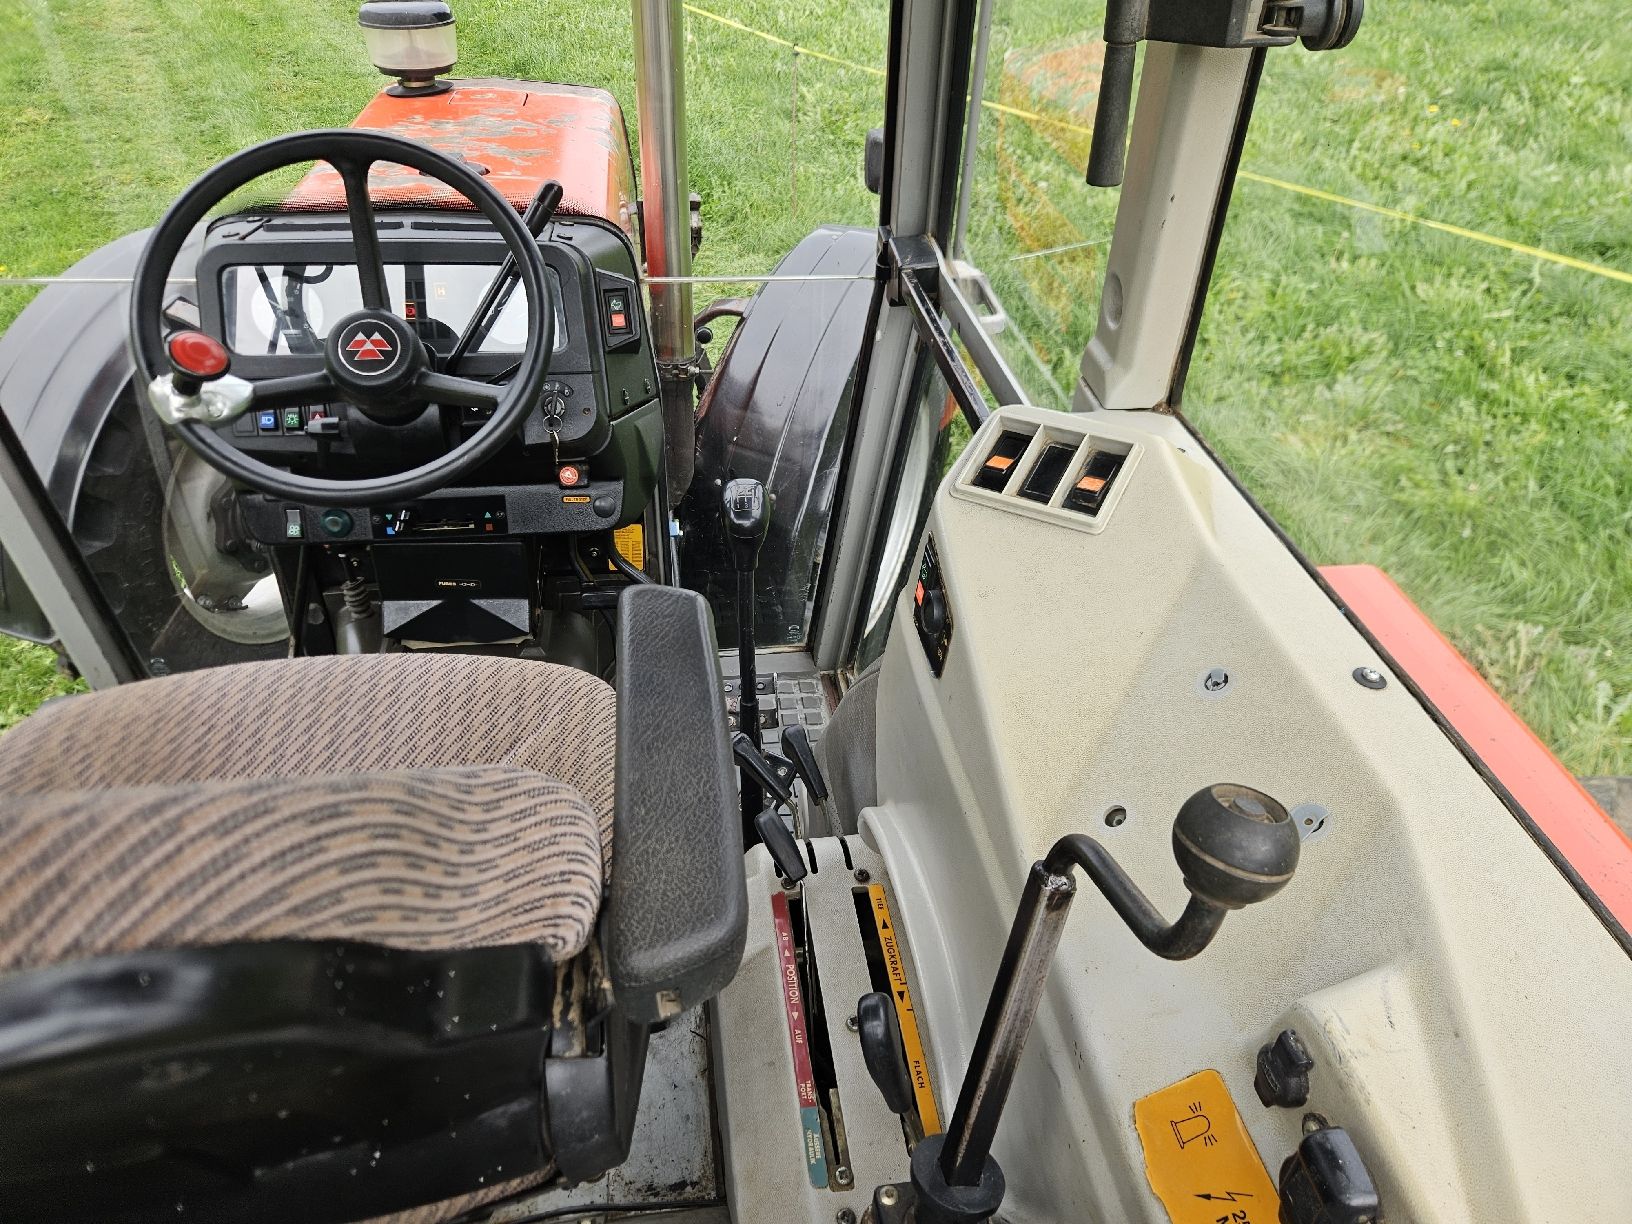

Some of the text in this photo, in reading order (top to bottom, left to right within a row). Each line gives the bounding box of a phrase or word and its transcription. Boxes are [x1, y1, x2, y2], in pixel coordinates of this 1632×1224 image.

[876, 897, 884, 910] TIEF
[782, 932, 789, 941] AB
[884, 936, 903, 983] ZUGKRAFT
[786, 964, 799, 1004] POSITION
[794, 1029, 803, 1045] AUF
[913, 1060, 925, 1089] FLACH
